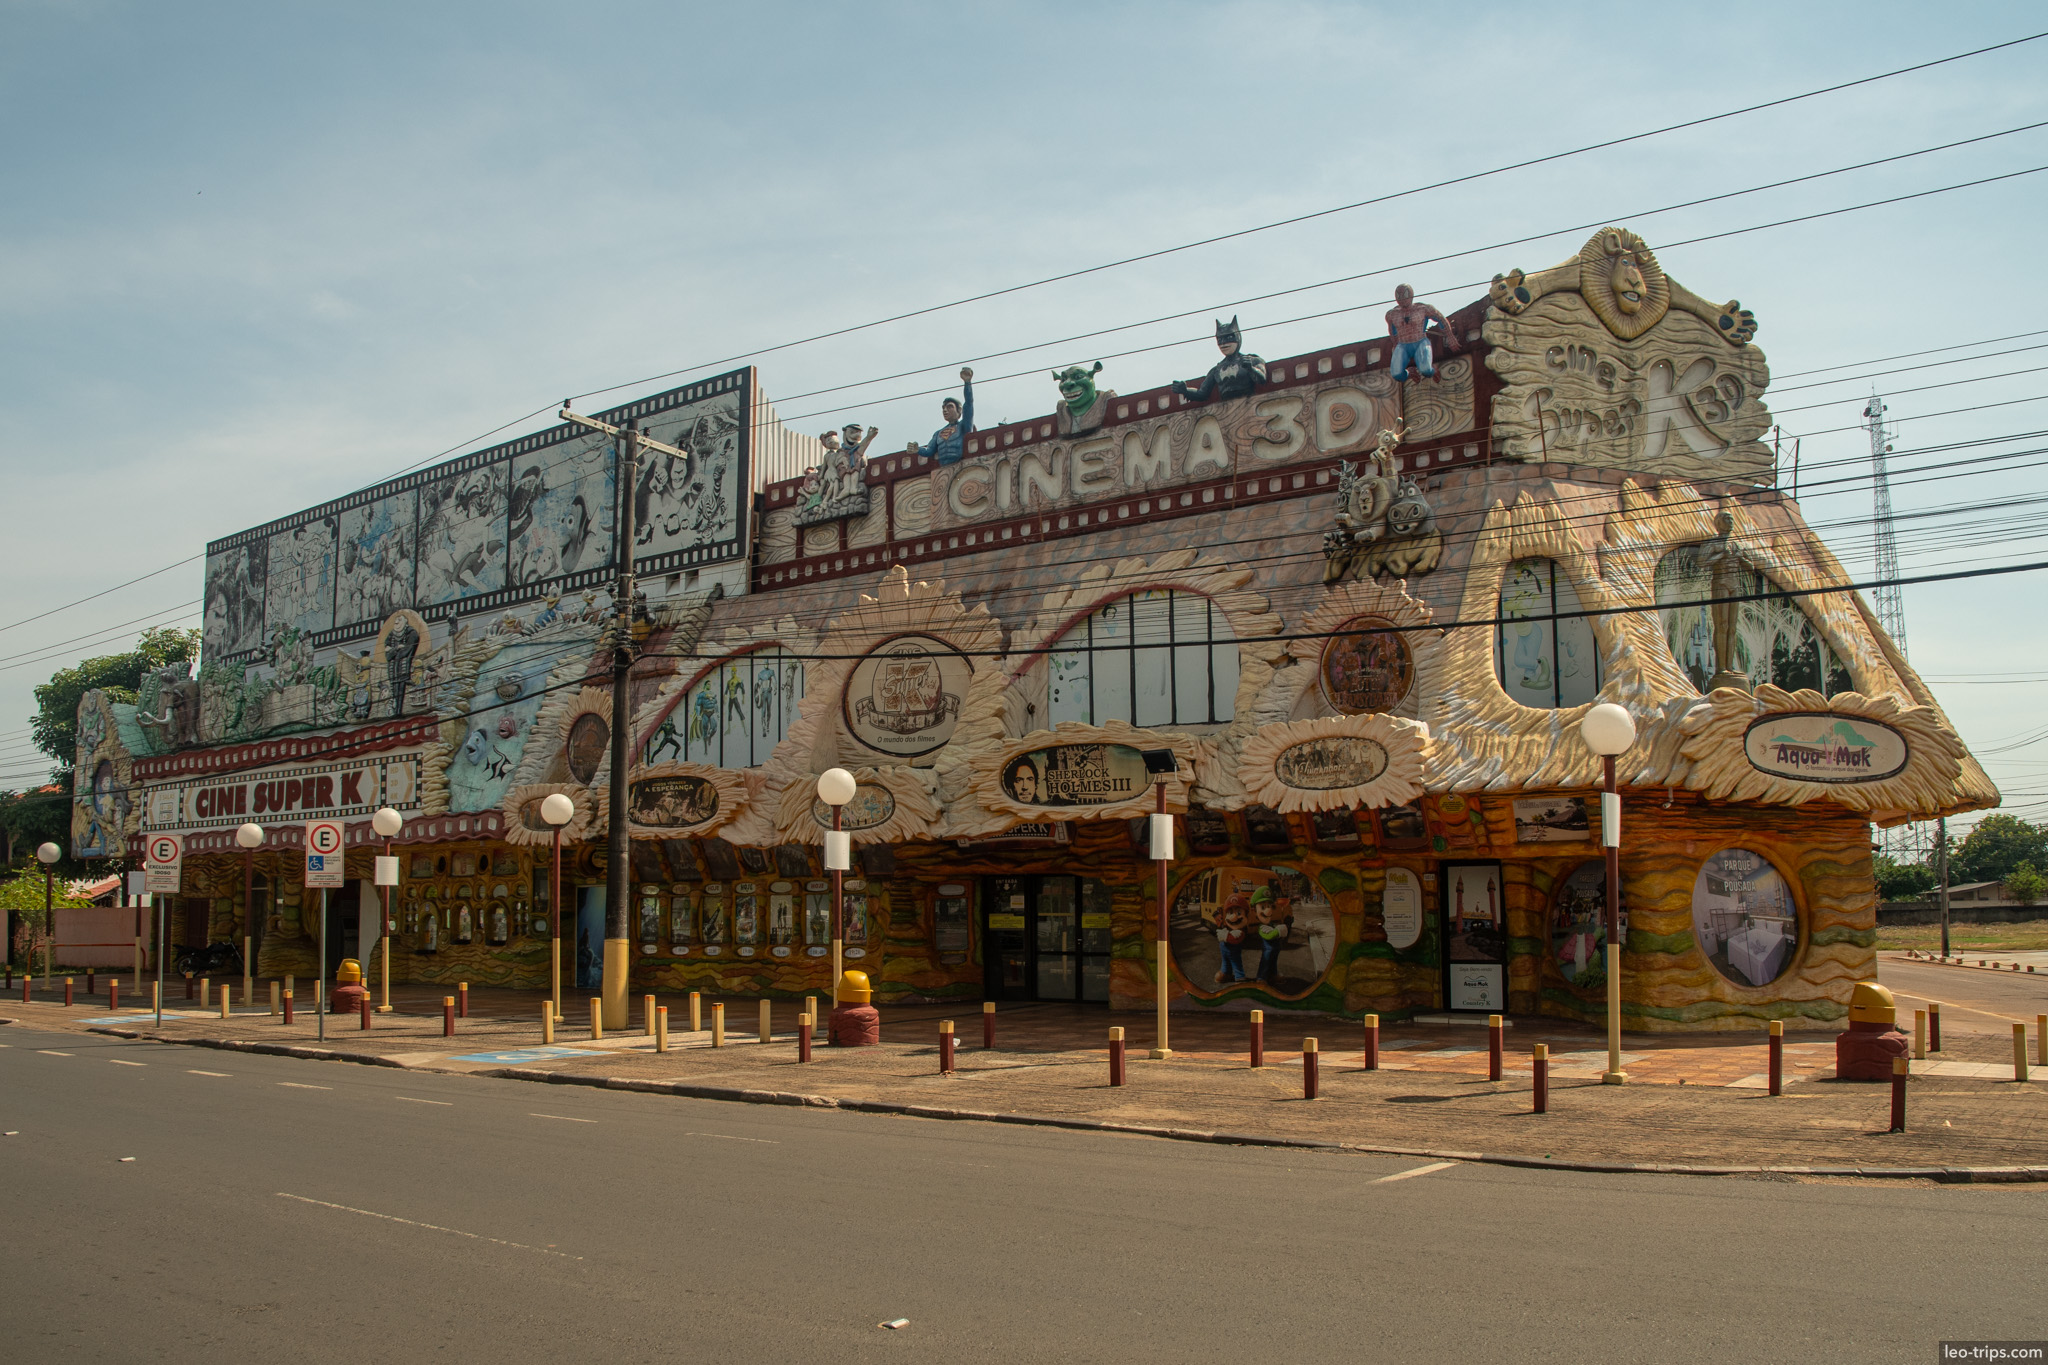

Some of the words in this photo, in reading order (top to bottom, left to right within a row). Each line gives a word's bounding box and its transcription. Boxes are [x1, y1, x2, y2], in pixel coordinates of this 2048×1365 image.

[1524, 387, 1642, 459] Super
[1643, 355, 1730, 459] K
[1694, 373, 1745, 424] 3D
[947, 415, 1229, 519] CINEMA
[1251, 386, 1374, 461] 3D
[881, 671, 928, 698] Super
[1776, 743, 1820, 769] Aqua
[1836, 746, 1871, 767] Mak
[1048, 767, 1110, 780] SHERLOCK
[195, 784, 248, 819] CINE
[252, 775, 334, 814] SUPER
[340, 770, 364, 806] K
[651, 784, 694, 792] ESPERANÇA
[1038, 823, 1048, 833] K
[320, 831, 330, 847] E
[159, 843, 169, 857] E
[1723, 859, 1752, 871] PARQUE
[1723, 880, 1757, 892] POUSADA
